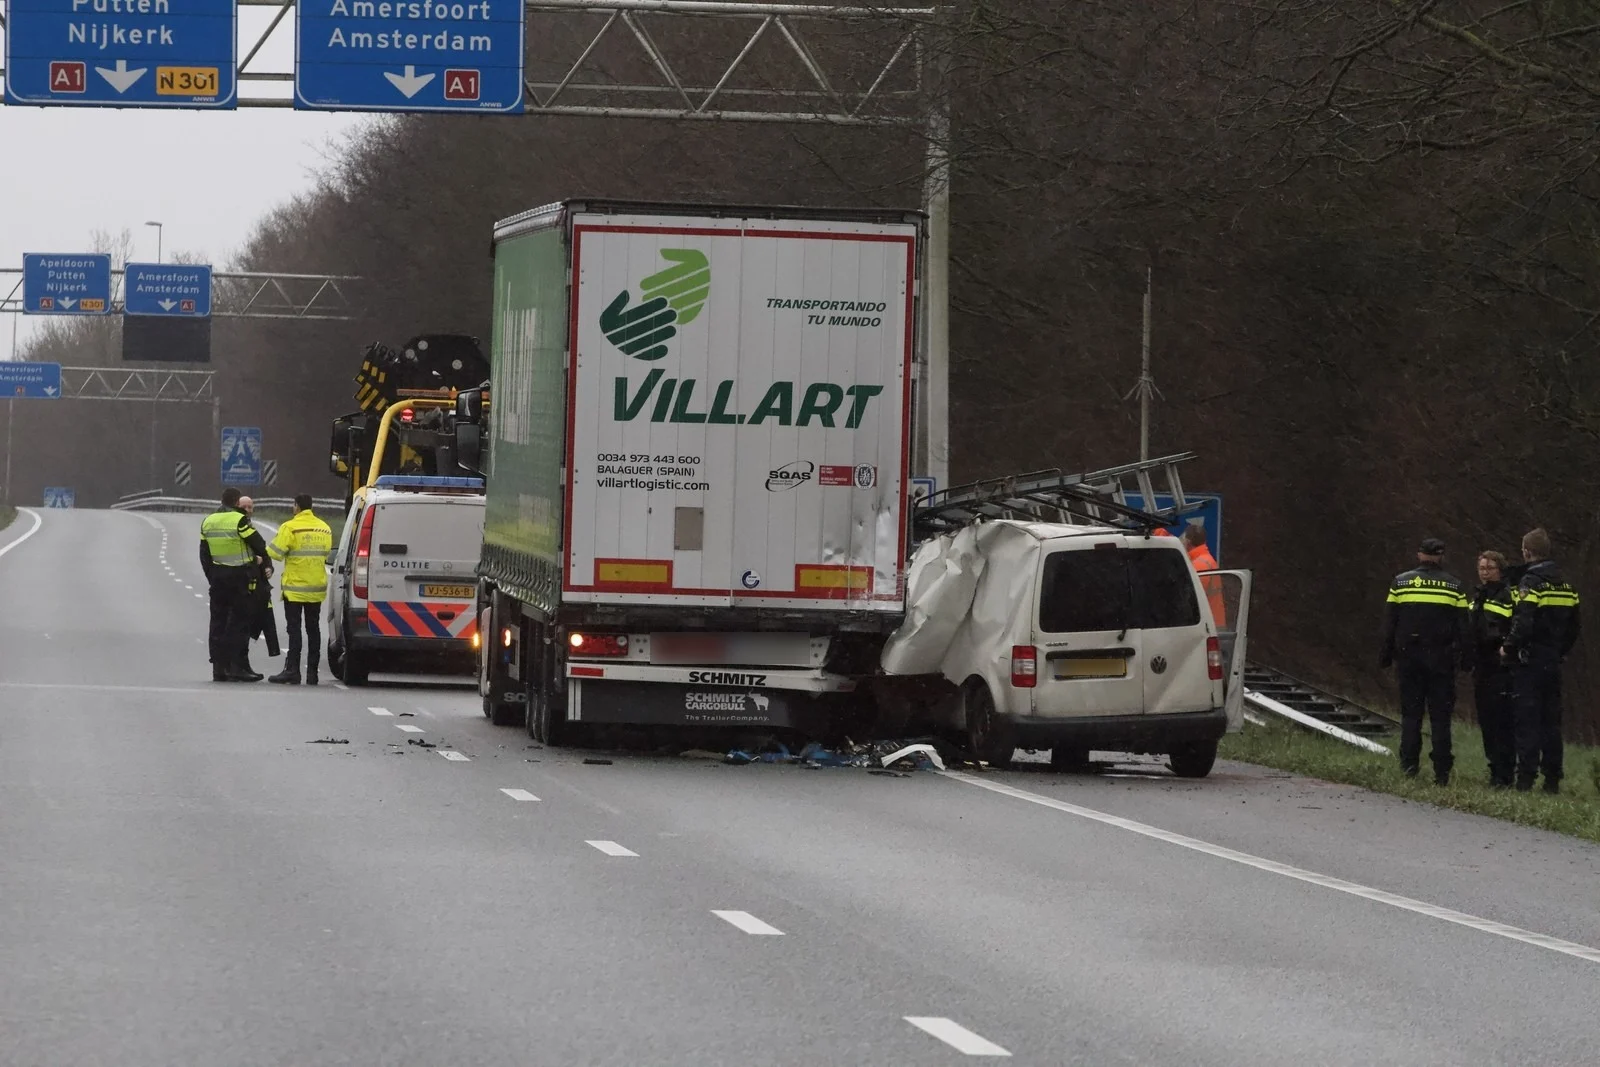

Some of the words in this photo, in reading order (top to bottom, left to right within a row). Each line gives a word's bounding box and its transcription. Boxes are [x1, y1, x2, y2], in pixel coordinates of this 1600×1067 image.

[73, 0, 169, 14] Putten
[330, 0, 490, 20] Amersfoort
[68, 23, 174, 49] Nijkerk
[328, 27, 491, 51] Amsterdam
[40, 259, 95, 268] Apeldoorn
[48, 270, 86, 279] Putten
[137, 272, 199, 282] Amersfoort
[46, 283, 87, 293] Nijkerk
[136, 284, 200, 294] Amsterdam
[766, 298, 887, 312] TRANSPORTANDO
[807, 315, 826, 325] TU
[828, 316, 882, 327] MUNDO
[613, 368, 884, 429] VILLART
[597, 454, 626, 462] 0034
[630, 454, 650, 463] 973
[653, 455, 675, 464] 443
[678, 456, 701, 464] 600
[597, 465, 653, 475] BALAGUER
[656, 467, 695, 477] (SPAIN)
[769, 470, 811, 480] SQAS
[596, 477, 710, 491] villartlogistic.com
[383, 560, 430, 569] POLITIE
[689, 671, 767, 686] SCHMITZ
[685, 692, 746, 703] SCHMITZ
[685, 702, 746, 710] CARGOBULL
